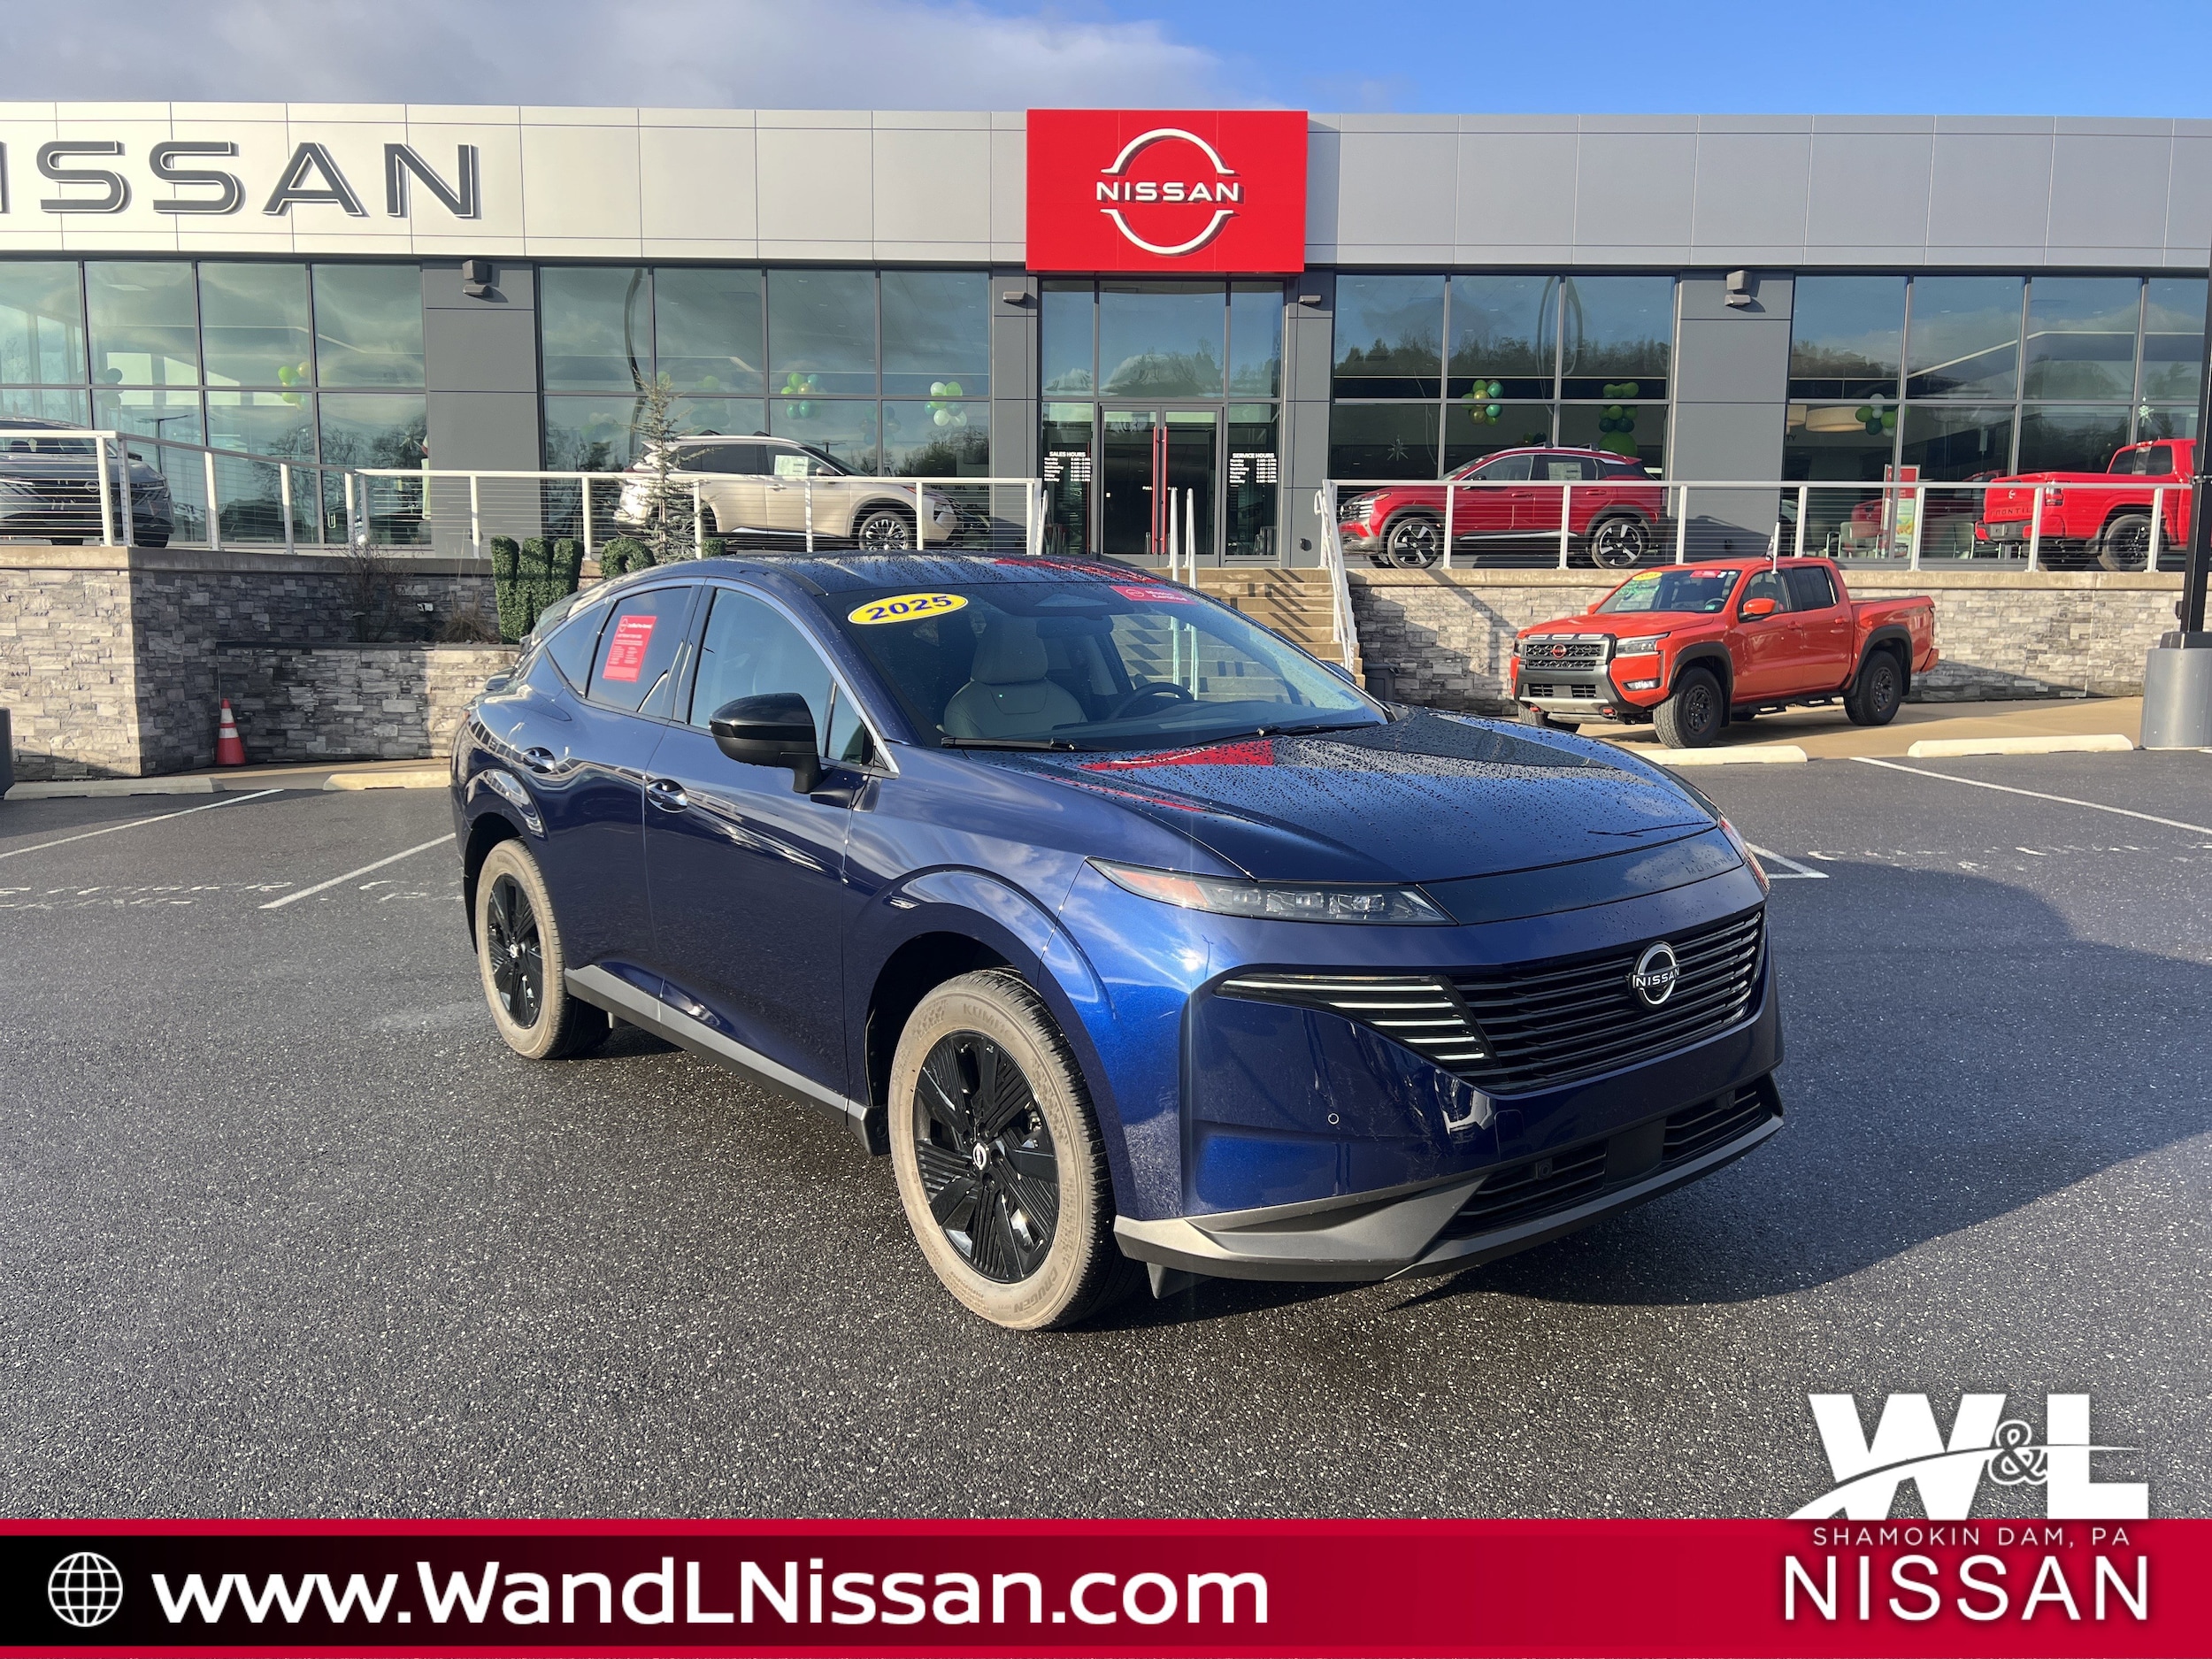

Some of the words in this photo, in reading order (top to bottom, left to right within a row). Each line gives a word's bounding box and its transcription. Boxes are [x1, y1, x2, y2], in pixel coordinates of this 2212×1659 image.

[0, 141, 478, 219] SSAN
[1096, 181, 1241, 203] NISSAN
[865, 595, 952, 621] 2025
[1635, 967, 1679, 987] NISSAN
